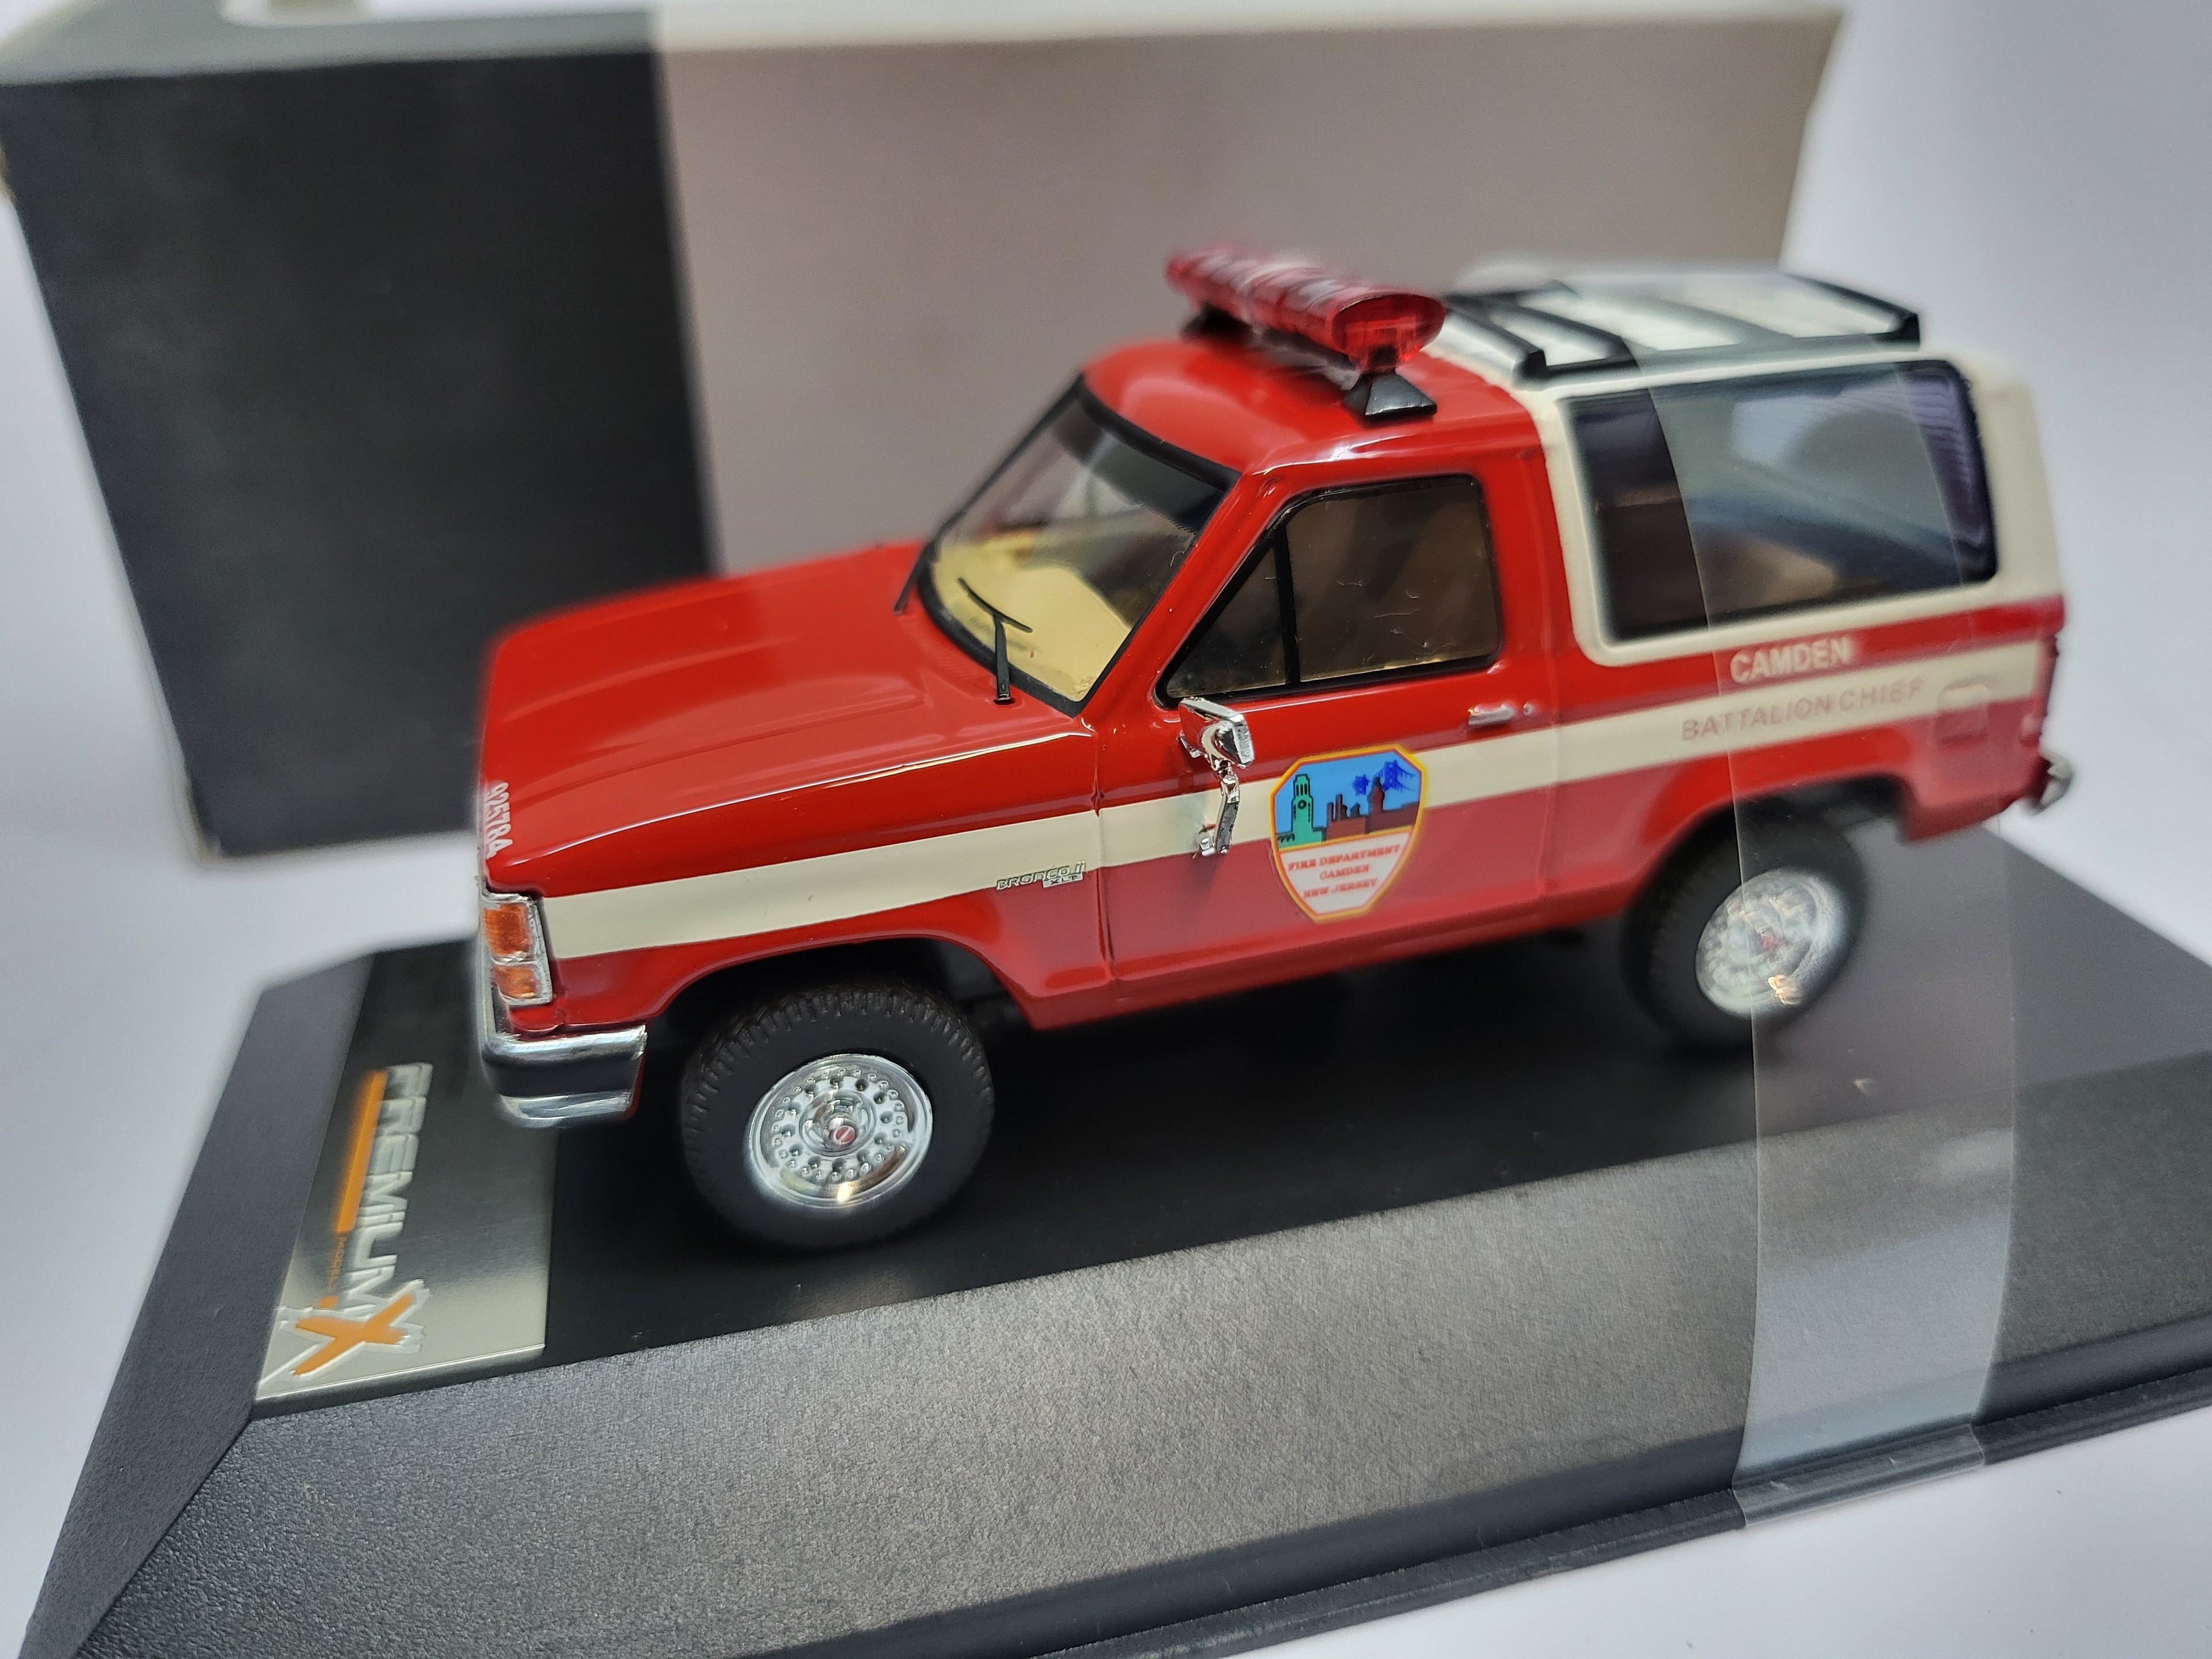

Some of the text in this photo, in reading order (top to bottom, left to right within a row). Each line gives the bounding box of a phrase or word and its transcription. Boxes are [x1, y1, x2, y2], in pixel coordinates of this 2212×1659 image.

[1729, 635, 1857, 684] CAMDEN
[1681, 679, 1924, 741] BATTALION CHIEF
[1289, 845, 1400, 871] FIRE DEPARTMENT
[996, 865, 1070, 891] BRONCO
[1050, 874, 1078, 886] XLT
[1320, 865, 1369, 880] CAMDEN
[344, 1063, 434, 1316] PREMIUM
